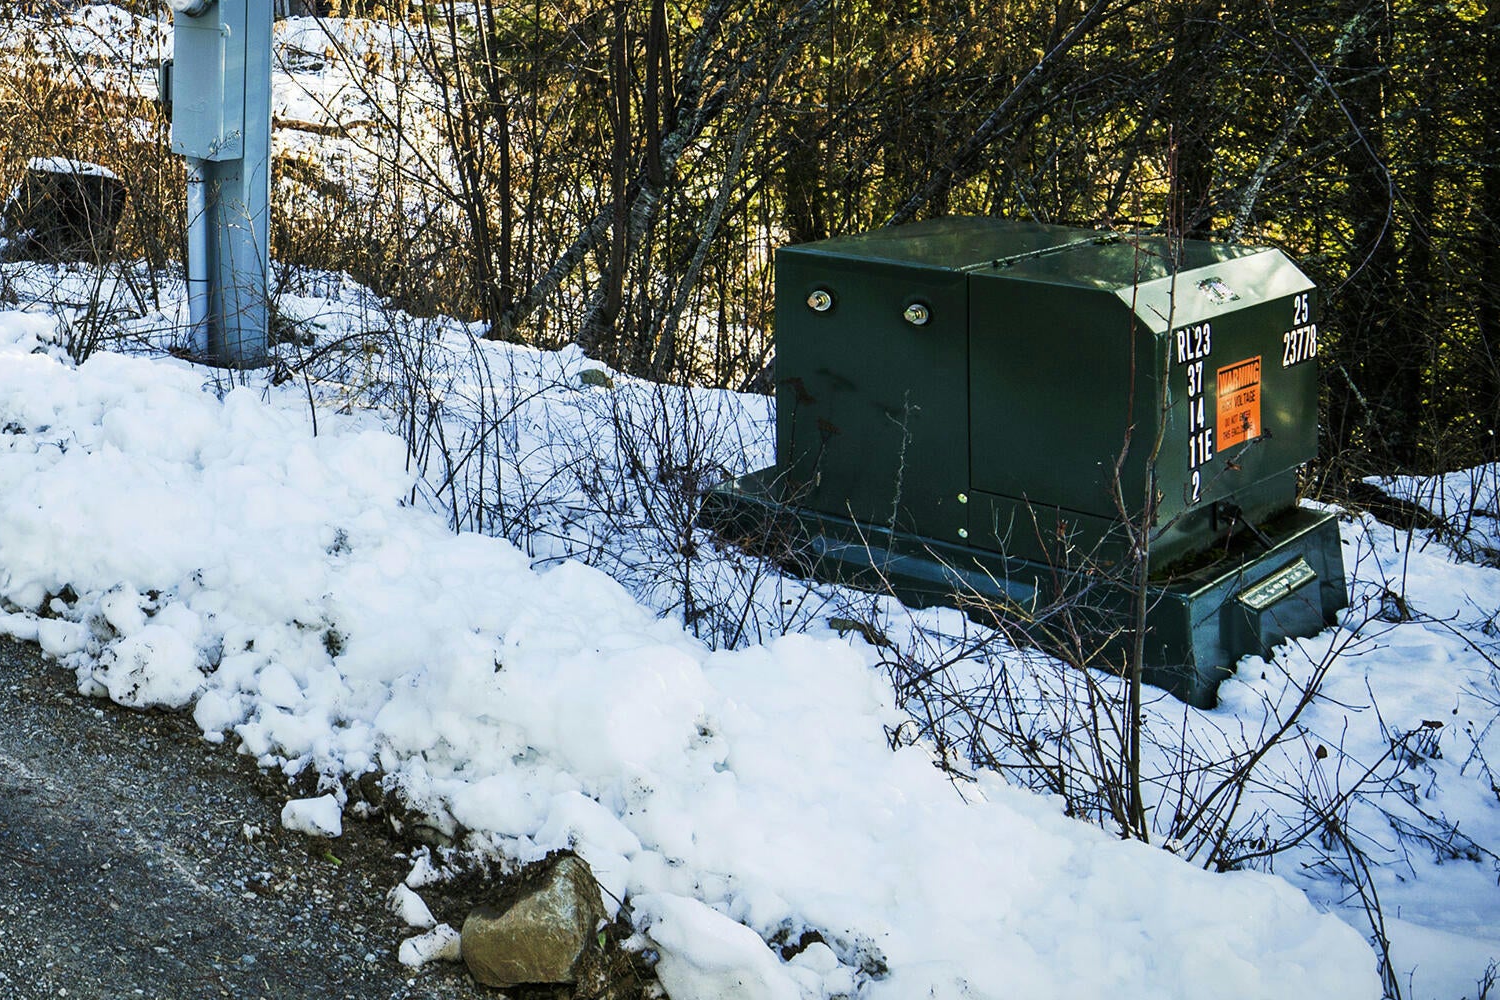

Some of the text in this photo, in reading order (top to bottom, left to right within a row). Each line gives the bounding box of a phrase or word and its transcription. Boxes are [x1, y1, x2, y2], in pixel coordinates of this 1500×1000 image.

[1294, 293, 1309, 326] 25
[1177, 322, 1211, 363] RL23
[1282, 324, 1317, 367] 23778
[1187, 361, 1203, 397] 37
[1219, 361, 1259, 396] WARNING
[1189, 428, 1212, 468] 11E
[1192, 470, 1200, 503] 2
